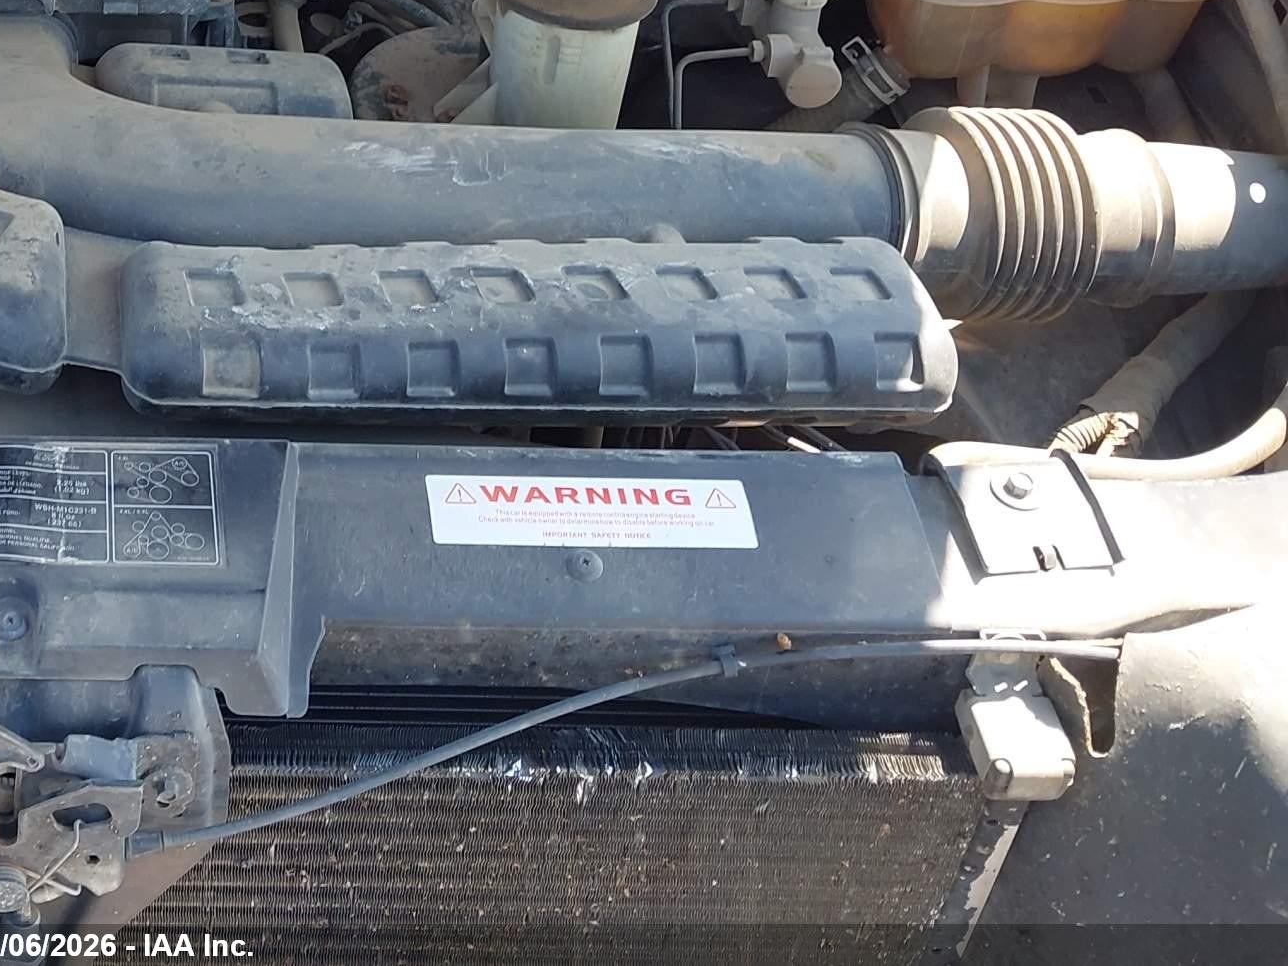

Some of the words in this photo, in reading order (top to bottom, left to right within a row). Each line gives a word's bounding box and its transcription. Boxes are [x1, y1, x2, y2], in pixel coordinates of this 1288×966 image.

[480, 485, 692, 506] WARNING
[542, 531, 587, 539] IMPORTANT
[591, 531, 621, 539] SAFETY
[624, 532, 652, 540] NOTICE
